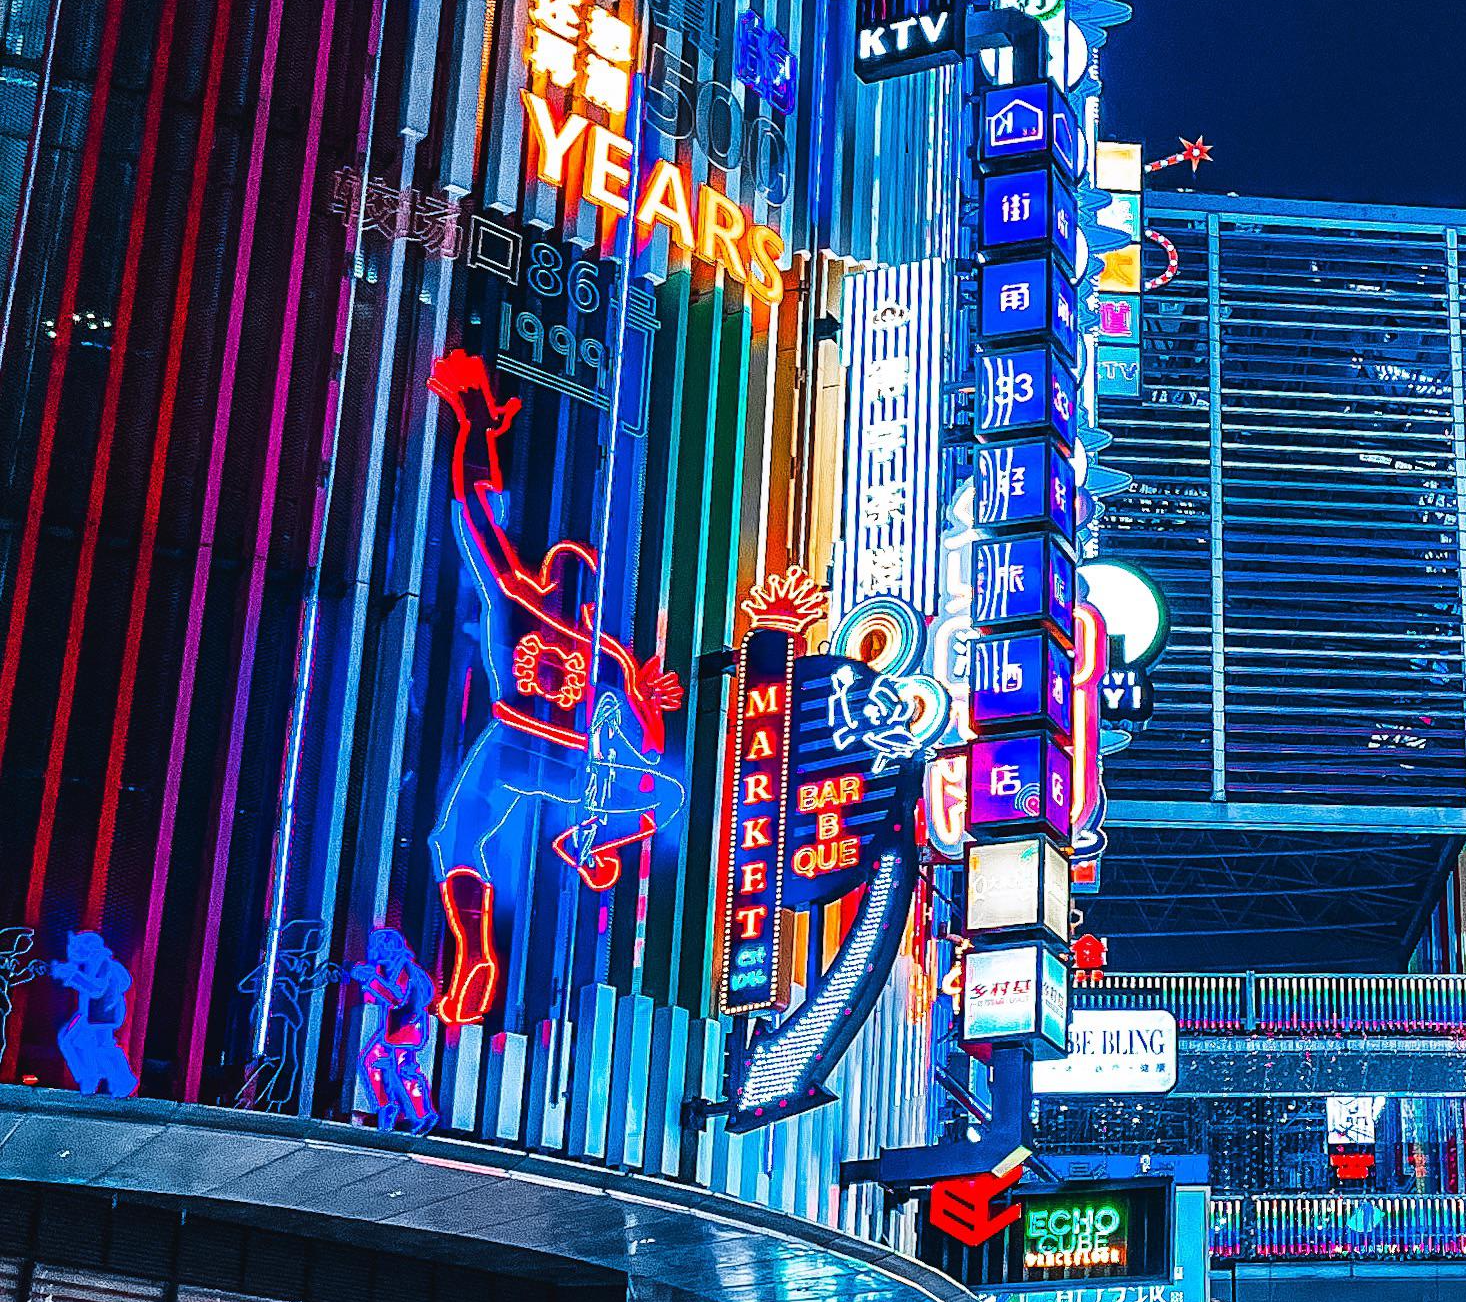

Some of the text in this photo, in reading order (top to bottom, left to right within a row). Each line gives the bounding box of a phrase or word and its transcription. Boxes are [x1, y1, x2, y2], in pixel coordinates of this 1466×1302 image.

[859, 12, 948, 59] KTV
[521, 88, 785, 307] YEARS
[527, 242, 601, 314] 86
[499, 301, 607, 390] 1999
[736, 688, 779, 940] MARKET
[798, 775, 862, 815] BAR
[819, 813, 841, 839] B
[792, 838, 860, 878] QUE
[1102, 1028, 1166, 1056] BLING
[1028, 1206, 1120, 1237] ECHO
[1038, 1232, 1110, 1254] CUBE
